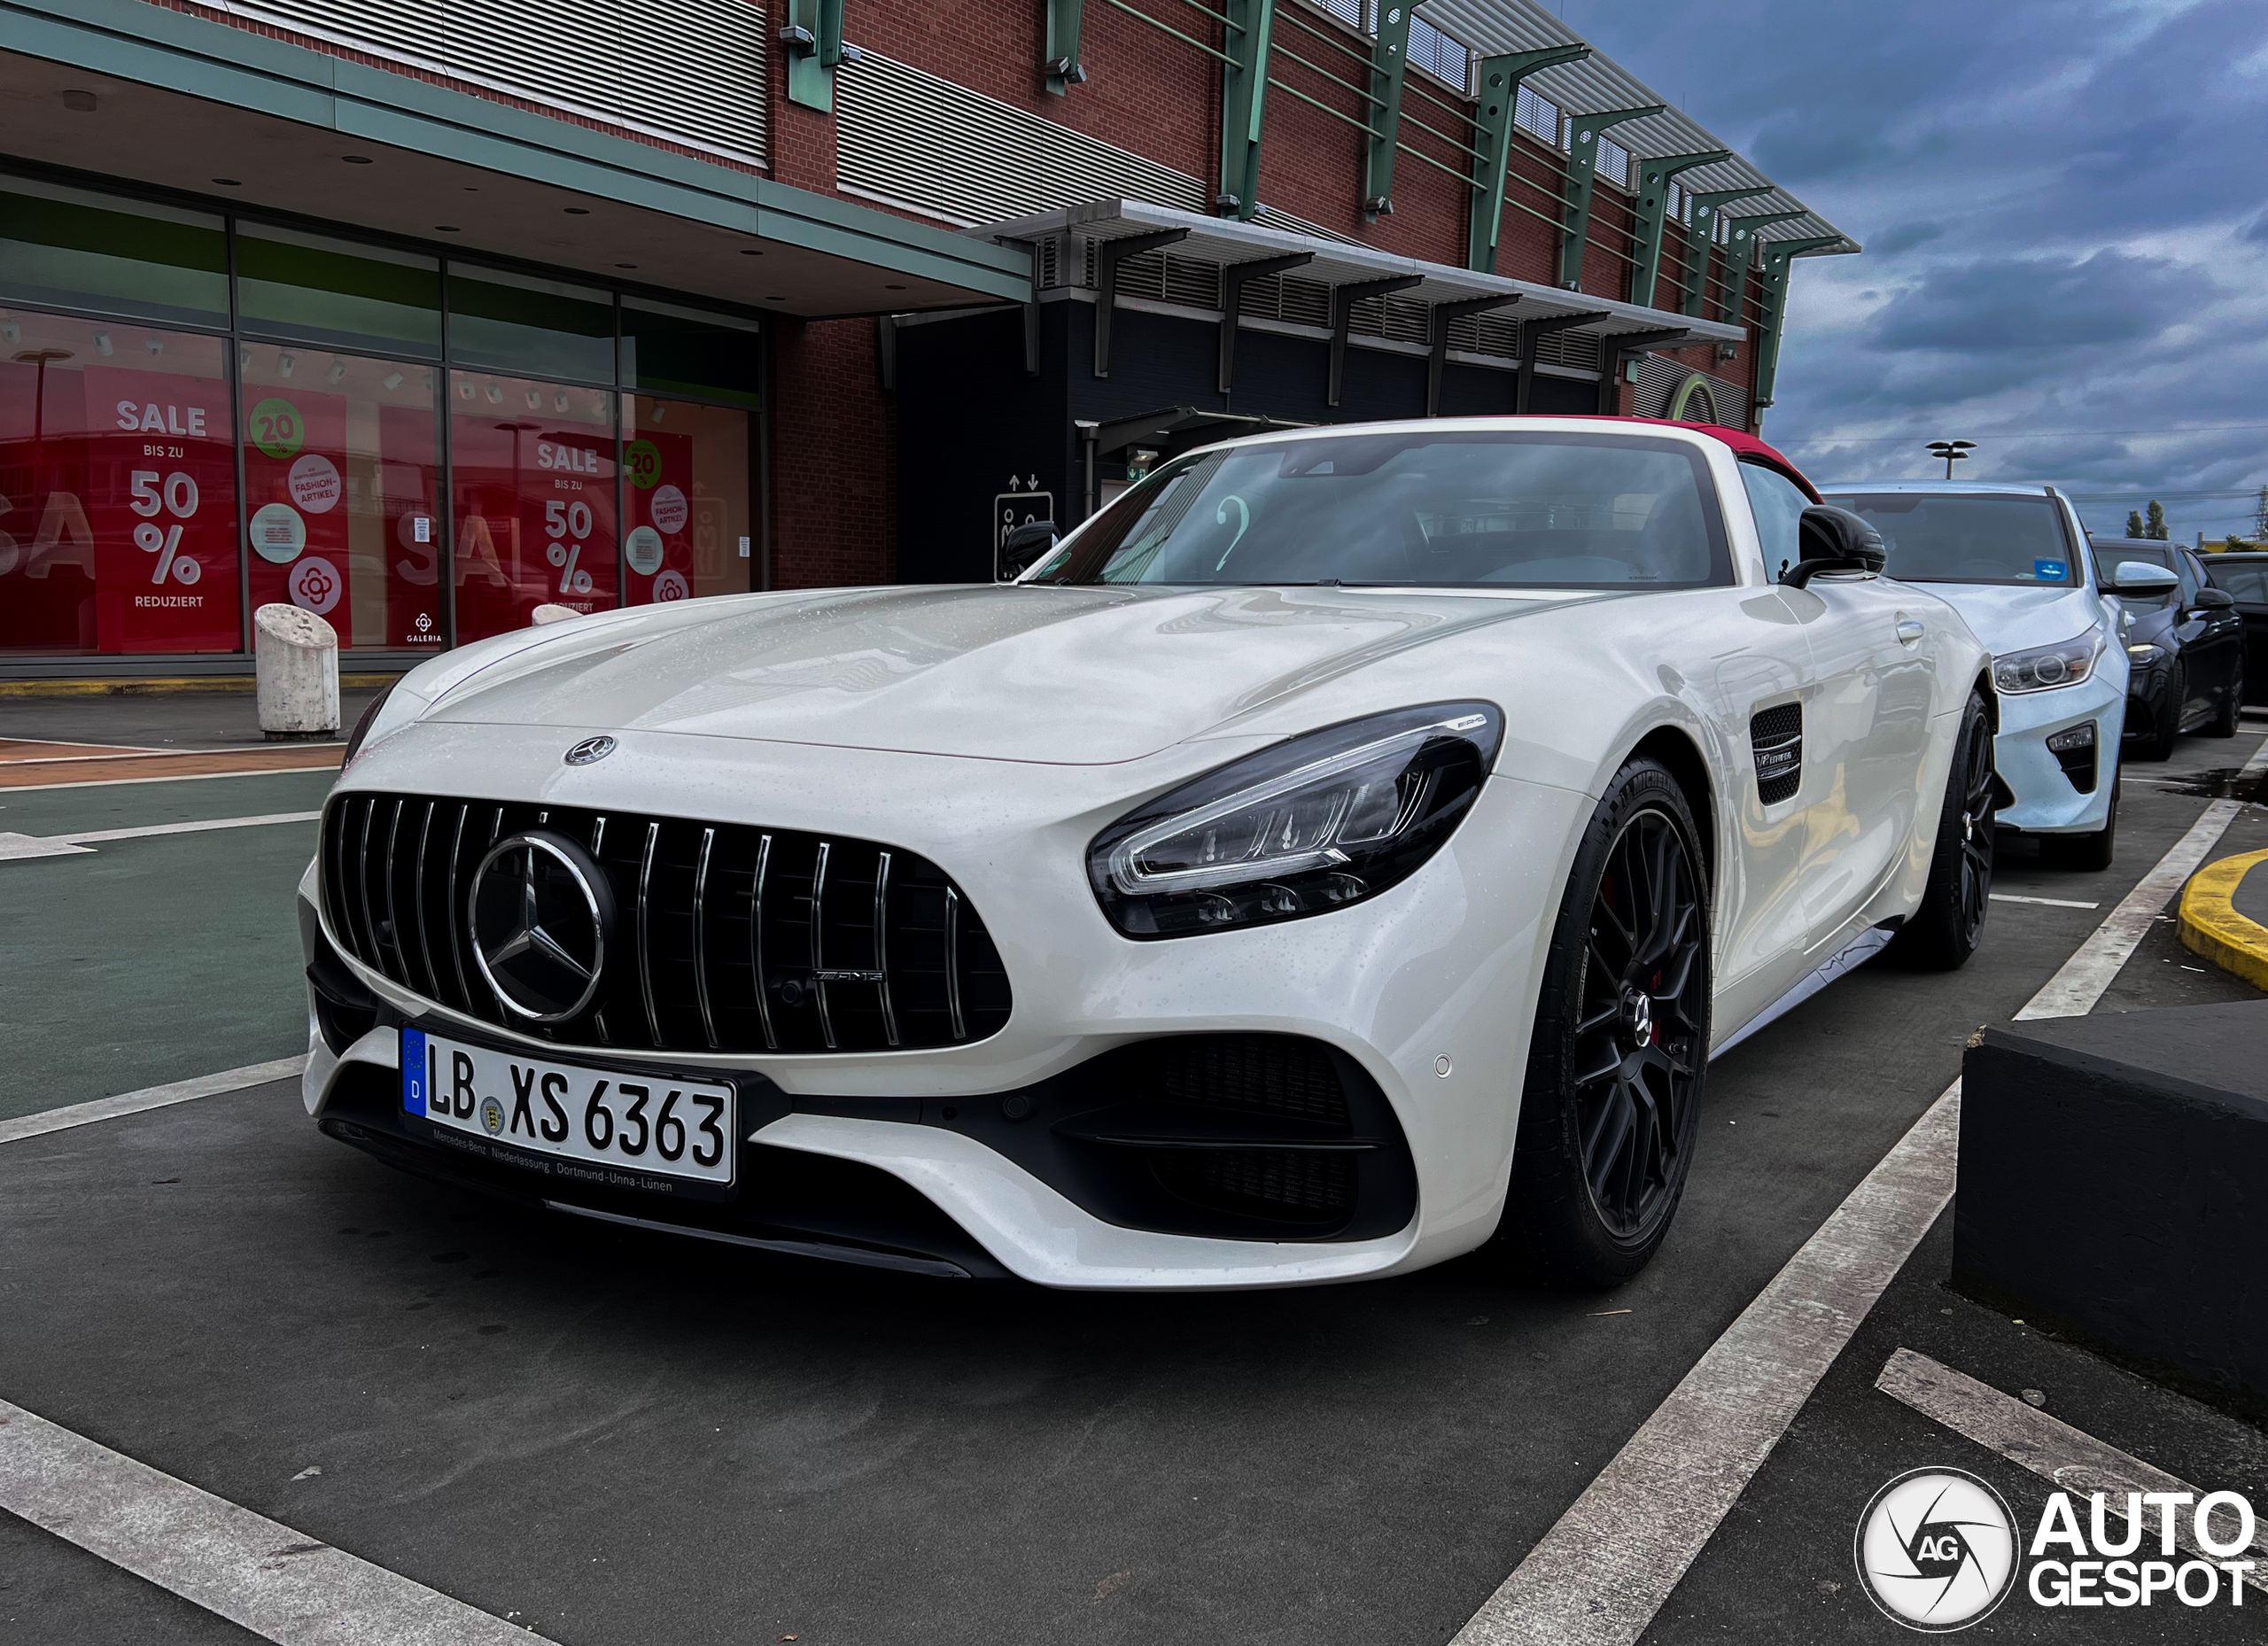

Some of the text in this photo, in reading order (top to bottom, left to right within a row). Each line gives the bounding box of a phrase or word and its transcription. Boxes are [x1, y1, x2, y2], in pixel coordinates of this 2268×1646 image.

[116, 400, 206, 437] SALE
[258, 414, 294, 442] 20
[144, 445, 184, 459] BIS ZU
[274, 442, 288, 454] %
[538, 443, 598, 473] SALE
[630, 453, 656, 475] 20
[295, 477, 337, 493] FASHION-
[555, 478, 583, 492] BIS ZU
[639, 474, 648, 485] %
[130, 470, 199, 518] 50
[301, 489, 336, 503] ARTIKEL
[544, 500, 593, 540] 50
[133, 522, 201, 586] %
[546, 541, 593, 594] %
[135, 595, 204, 608] REDUZIERT
[407, 634, 442, 643] GALERIA
[1756, 753, 1770, 768] V8
[411, 1080, 420, 1099] D
[429, 1044, 726, 1169] LB XS 6363
[433, 1129, 673, 1192] Mercedes-Benz Niederlassung Dortmund-Unna-Lünen
